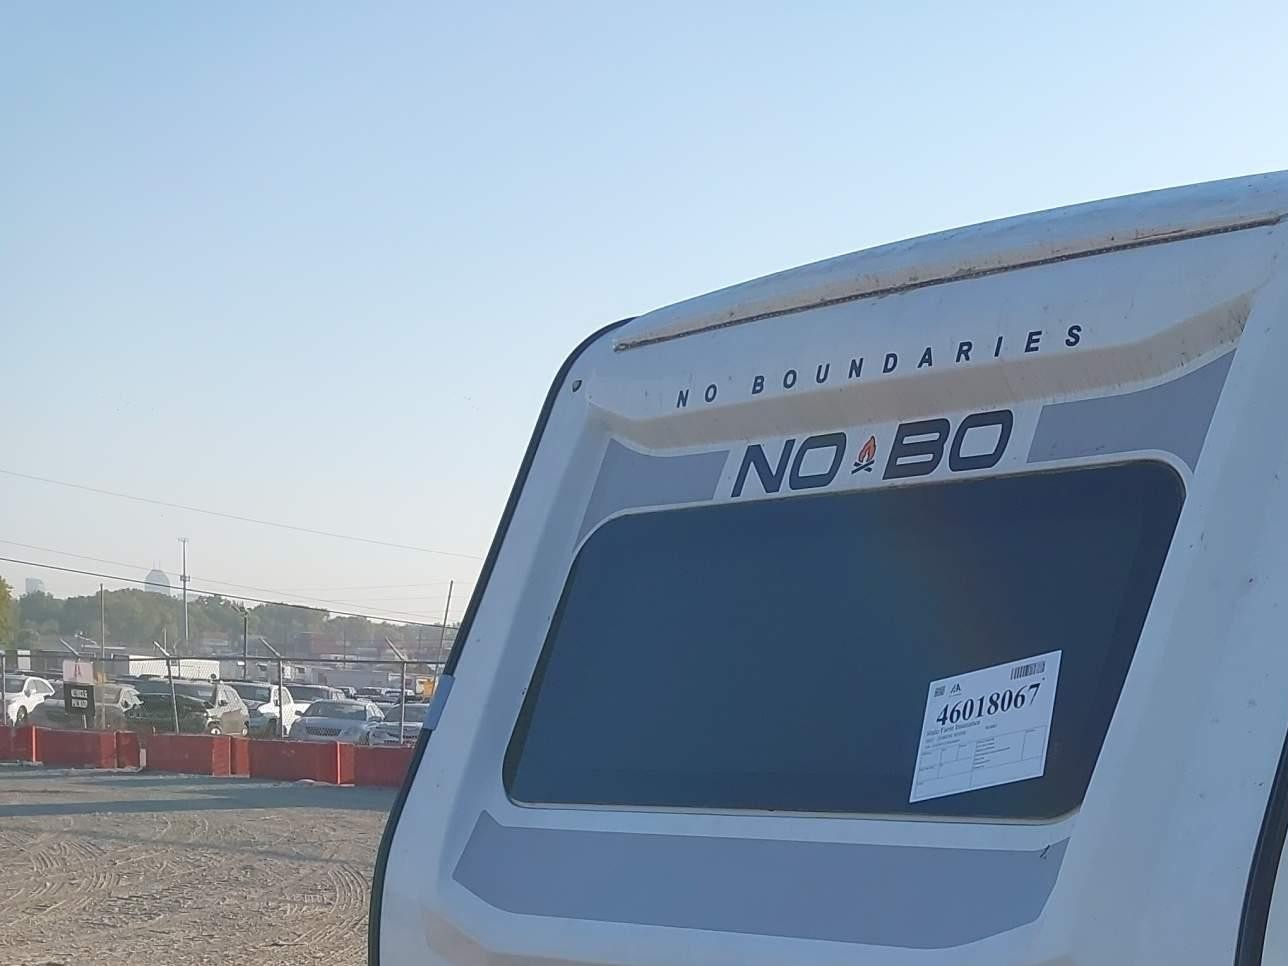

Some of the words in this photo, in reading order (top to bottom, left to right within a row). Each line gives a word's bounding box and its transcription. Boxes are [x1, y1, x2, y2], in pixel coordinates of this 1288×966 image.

[676, 384, 718, 408] NO
[751, 324, 1083, 396] BOUNDARIES
[936, 683, 1041, 726] 46018067
